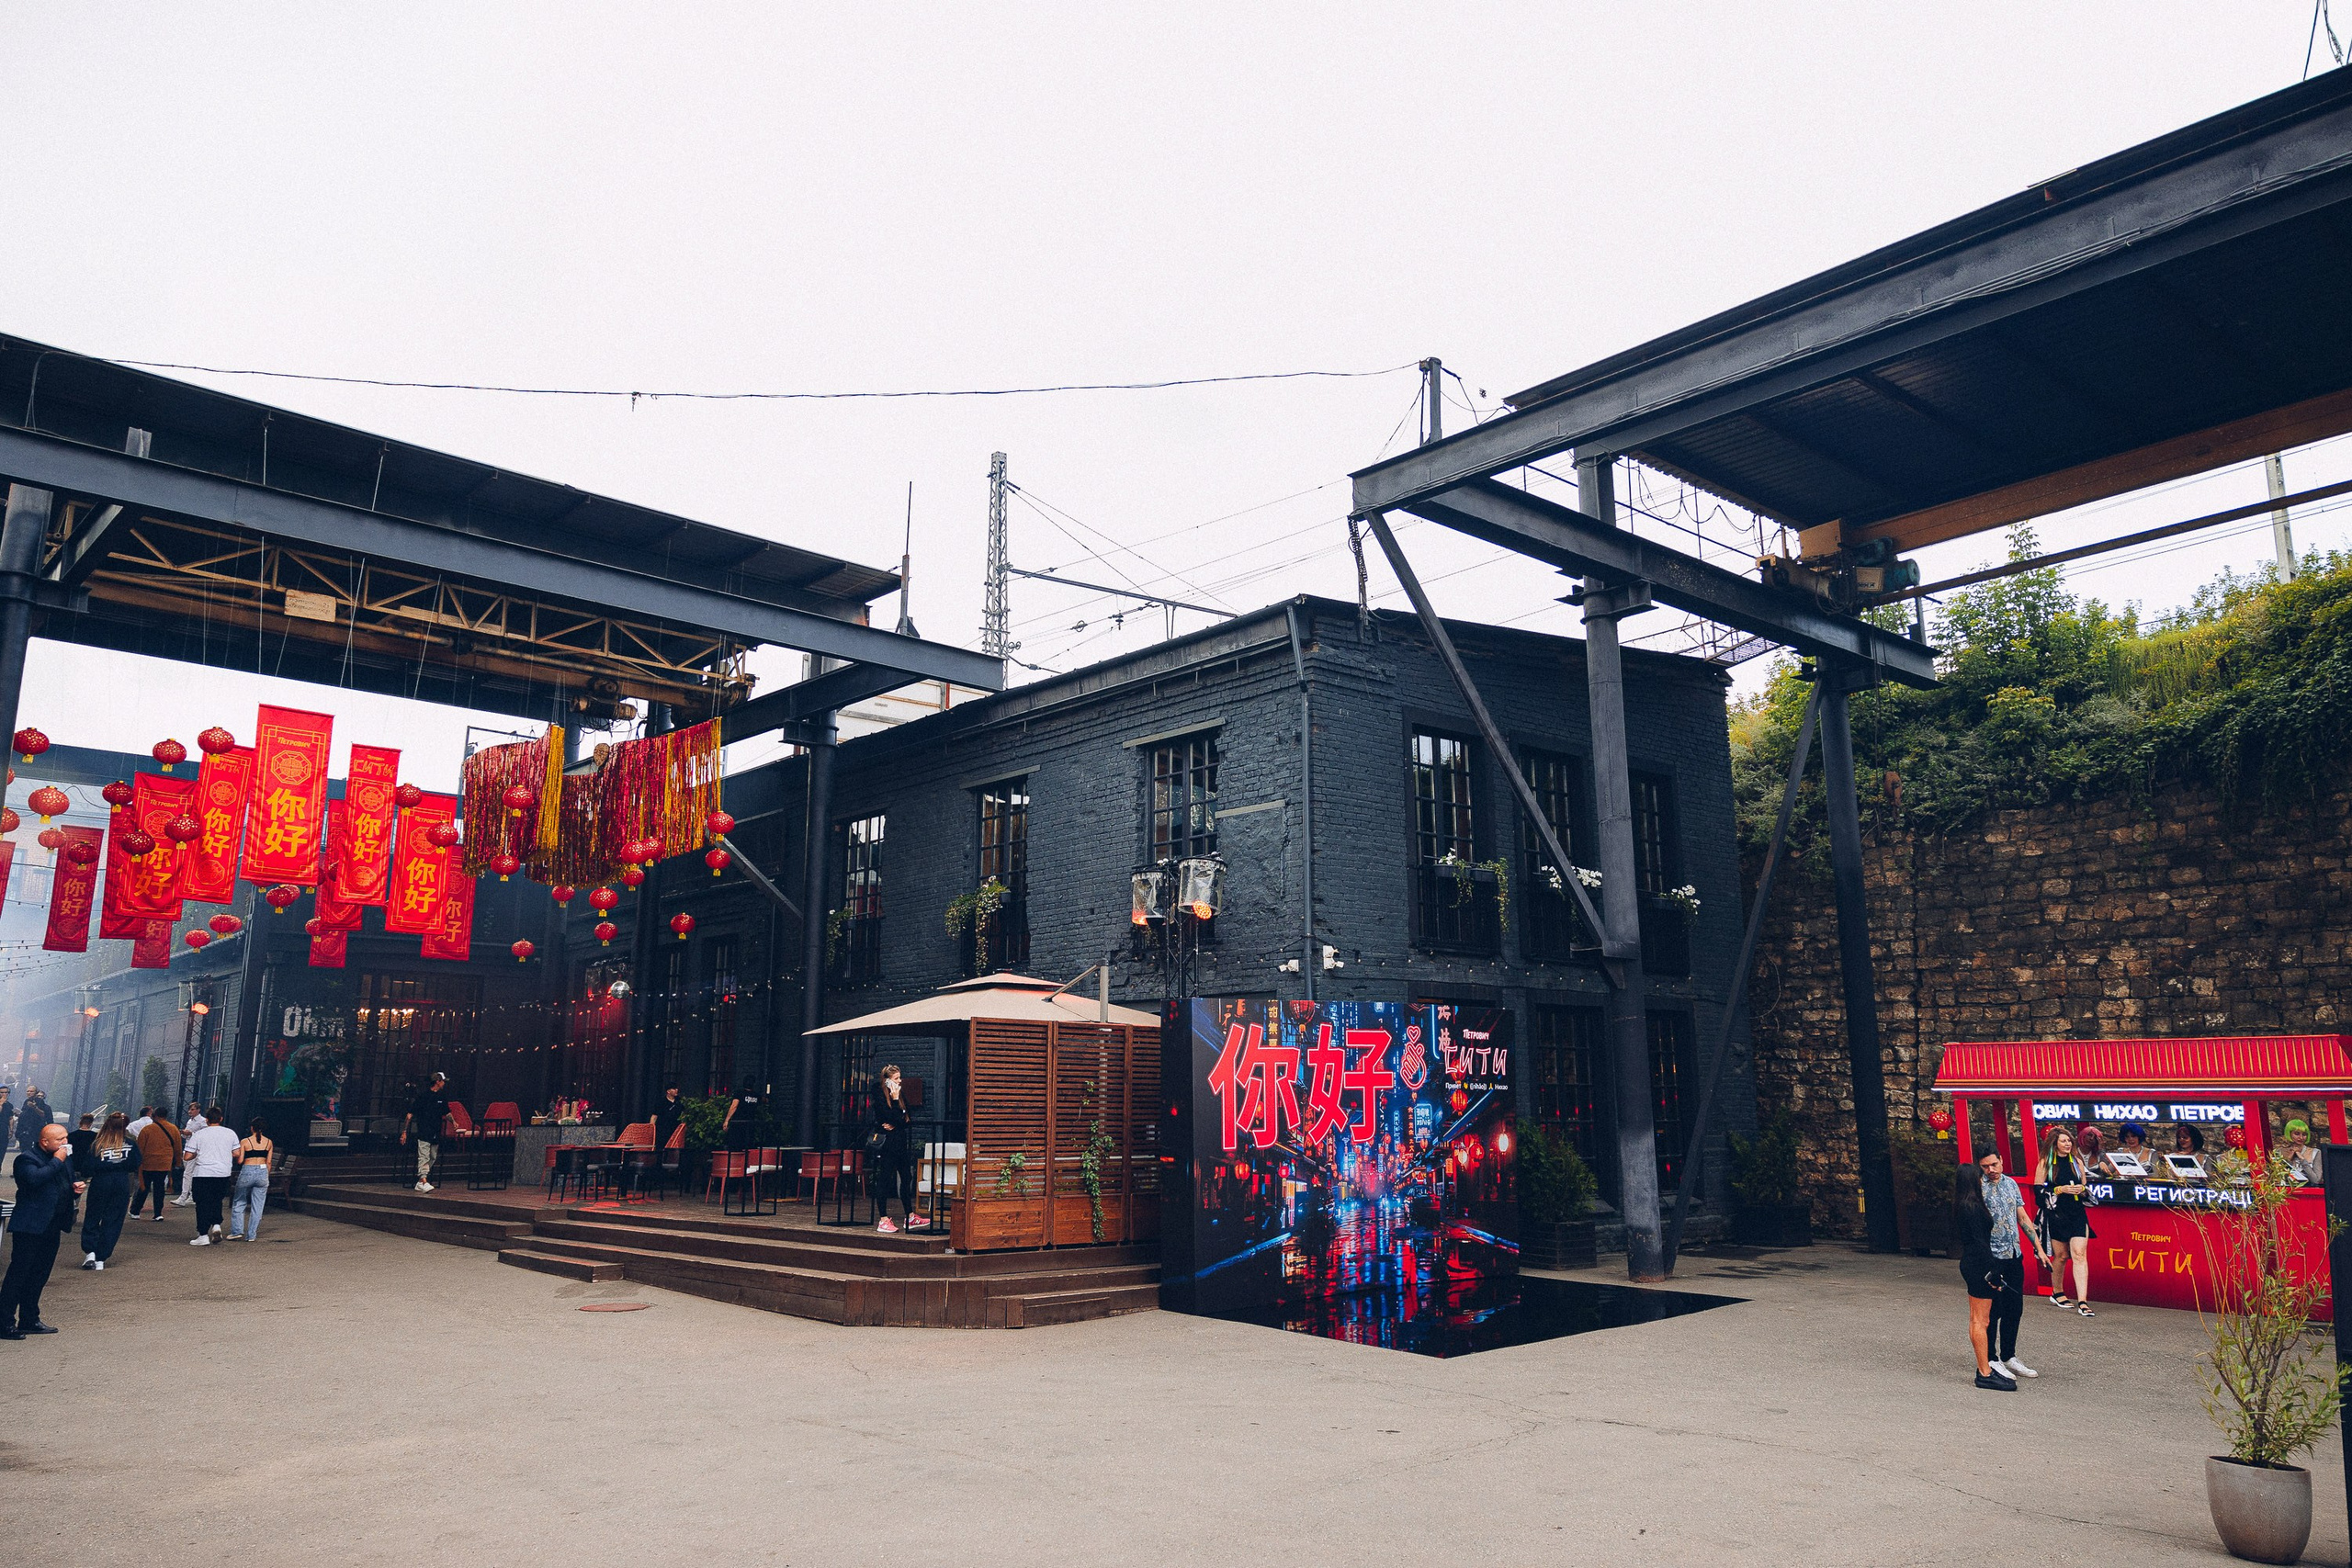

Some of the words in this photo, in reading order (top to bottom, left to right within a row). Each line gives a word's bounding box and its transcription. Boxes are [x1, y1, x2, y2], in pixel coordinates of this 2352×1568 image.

[353, 759, 396, 778] СИТИ
[200, 807, 232, 859] 你好
[263, 787, 308, 858] 你好
[352, 812, 382, 864] 你好
[133, 842, 173, 899] 你好
[402, 856, 437, 914] 你好
[61, 877, 86, 918] 你好
[1445, 1046, 1508, 1076] СИТИ
[1208, 1022, 1395, 1150] 你好
[2094, 1104, 2158, 1121] НИХАО
[2130, 1231, 2172, 1243] ПЕТРОВИЧ
[2108, 1247, 2194, 1276] СИТИ
